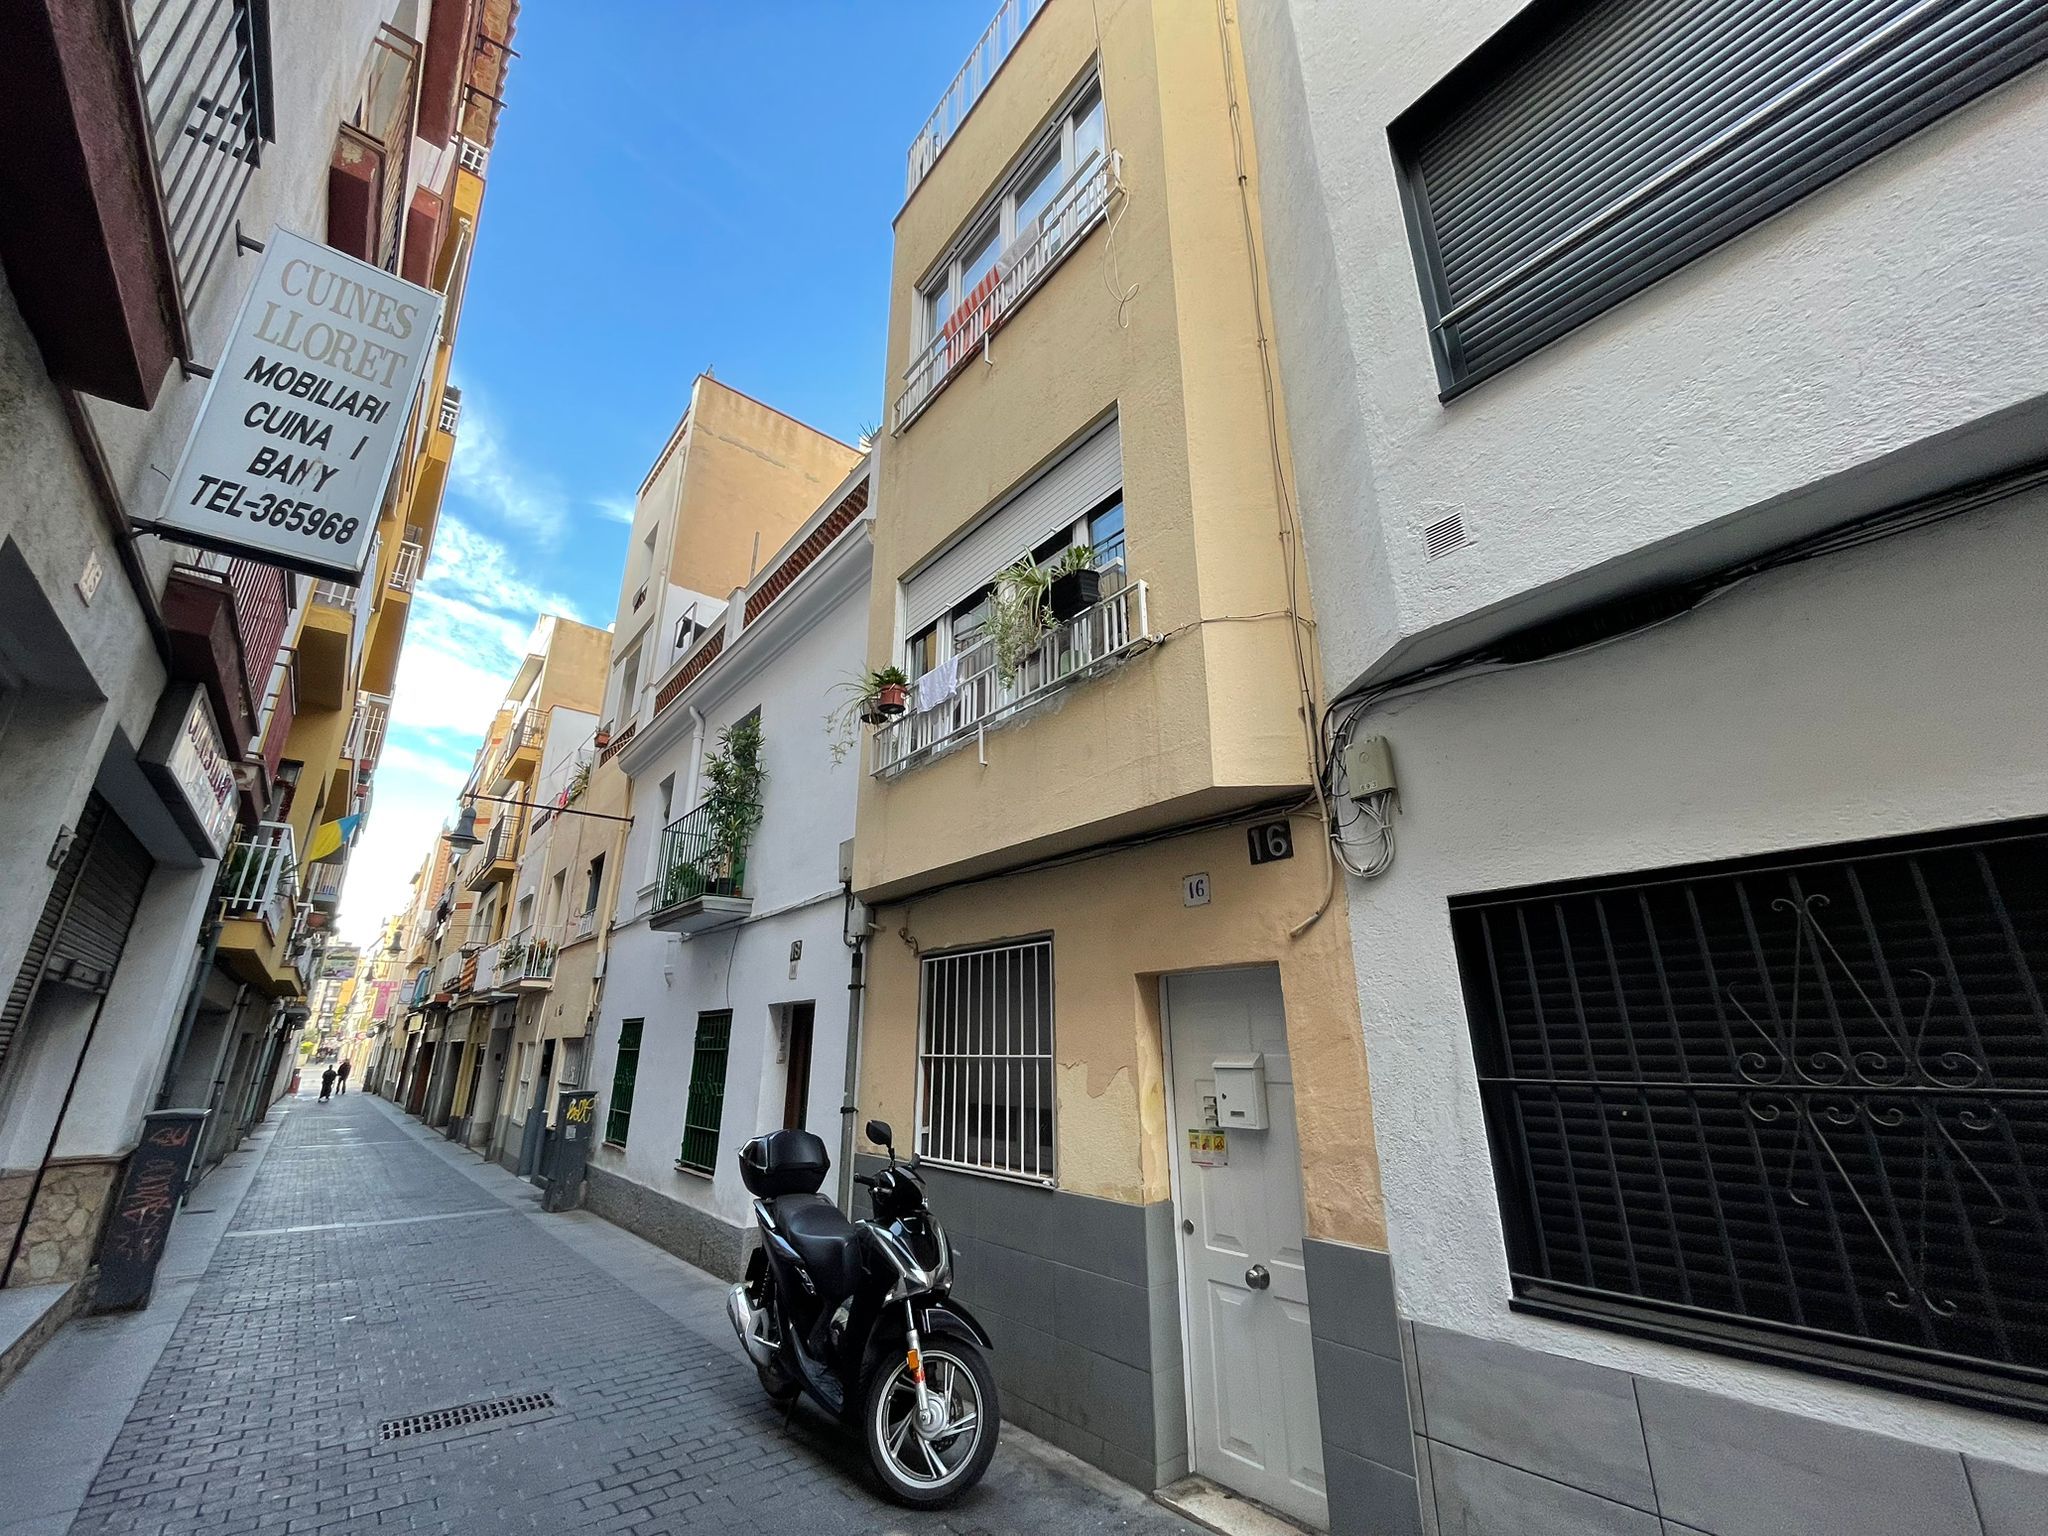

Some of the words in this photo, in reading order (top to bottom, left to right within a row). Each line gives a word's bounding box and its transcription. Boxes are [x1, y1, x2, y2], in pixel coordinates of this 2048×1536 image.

[280, 258, 419, 340] CUINES
[252, 300, 409, 389] LLORET
[243, 355, 391, 425] MOBILIARI
[243, 401, 334, 452] CUINA
[349, 435, 370, 461] I
[245, 446, 340, 493] BANY
[189, 473, 360, 545] TEL-365968
[1250, 824, 1289, 861] 16
[1189, 879, 1205, 899] 16
